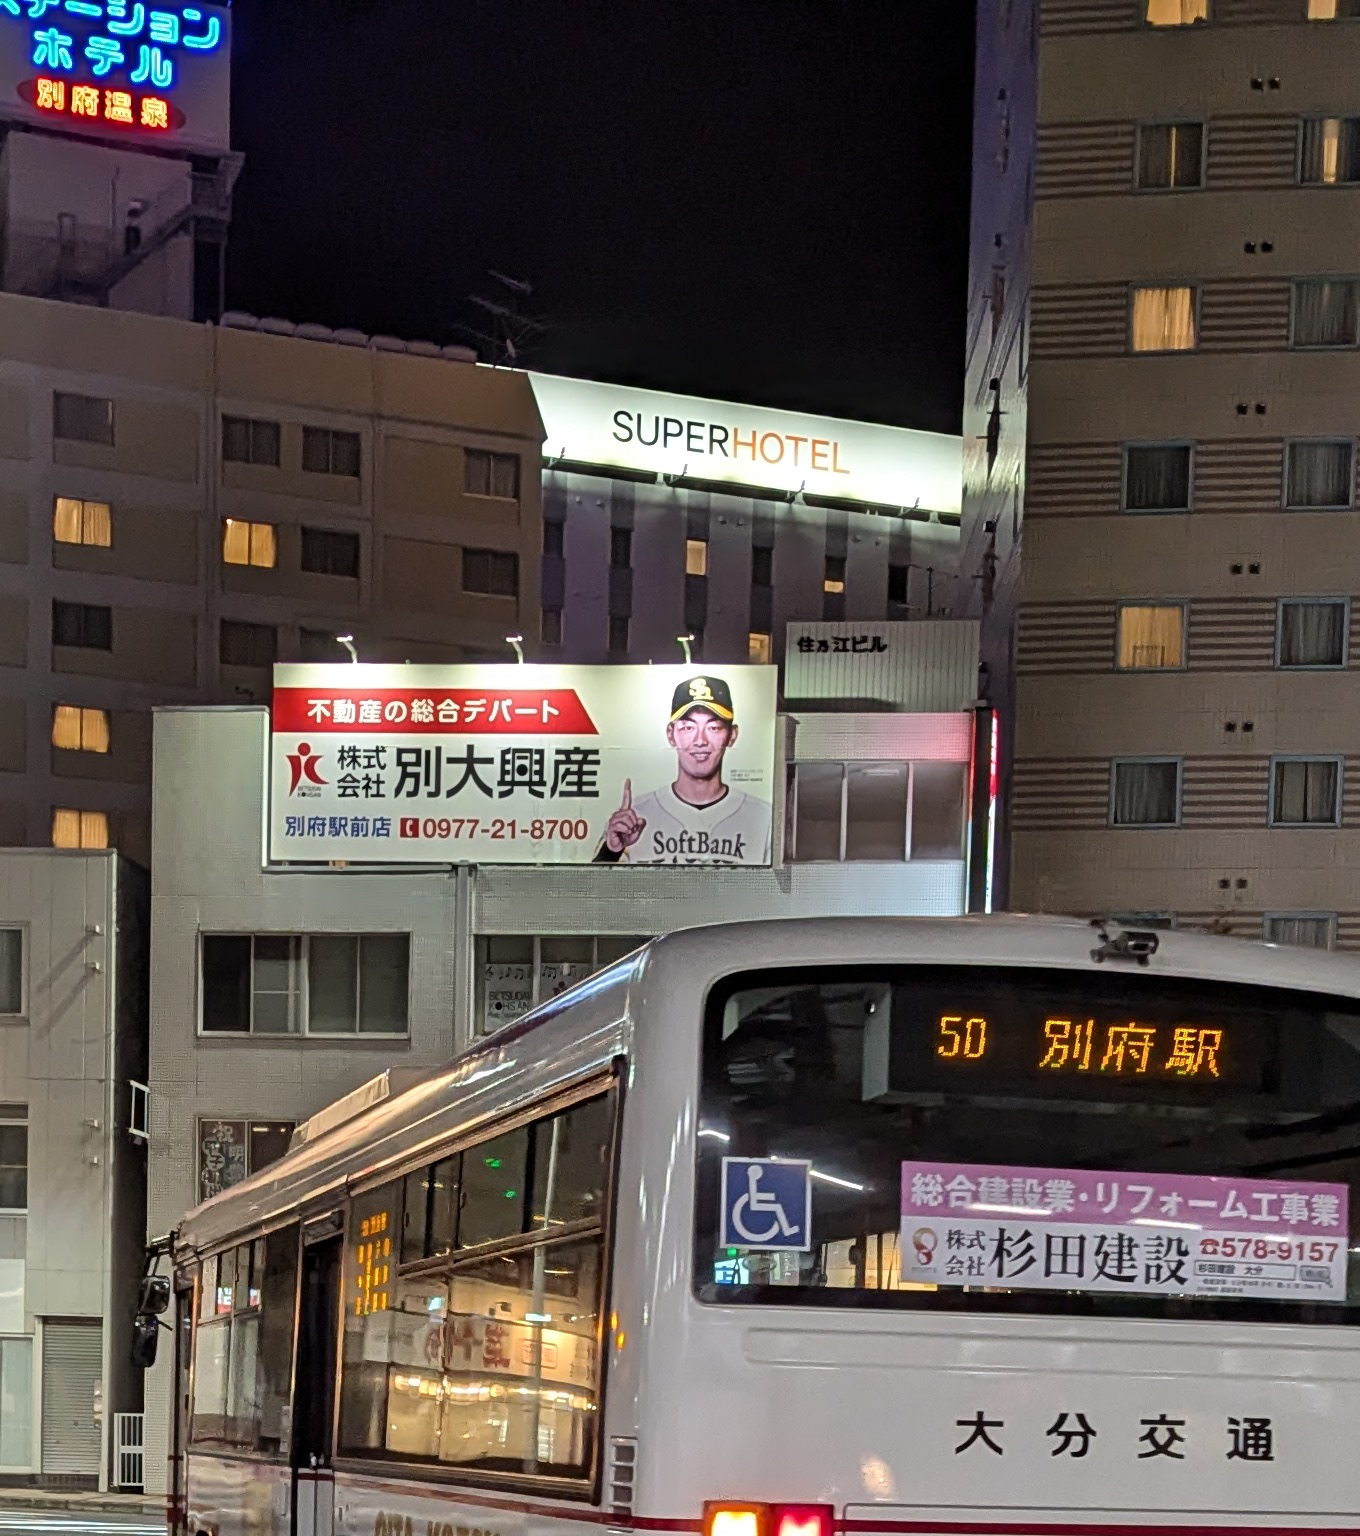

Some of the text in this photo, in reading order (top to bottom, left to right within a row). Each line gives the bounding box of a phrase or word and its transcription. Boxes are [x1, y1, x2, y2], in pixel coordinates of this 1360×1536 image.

[32, 28, 173, 87] ホテル
[36, 78, 168, 128] 別府温泉
[307, 699, 559, 724] 不動産の総合デパート
[394, 744, 601, 800] 別大興産
[285, 816, 588, 840] 別府駅前店 0977-21-8700
[653, 829, 747, 859] SoftBank
[938, 1017, 1223, 1077] 50 別府駅
[910, 1172, 1340, 1228] 総合建設業・リフォーム工事業
[989, 1226, 1189, 1286] 杉田建設
[954, 1411, 1275, 1461] 大分交通
